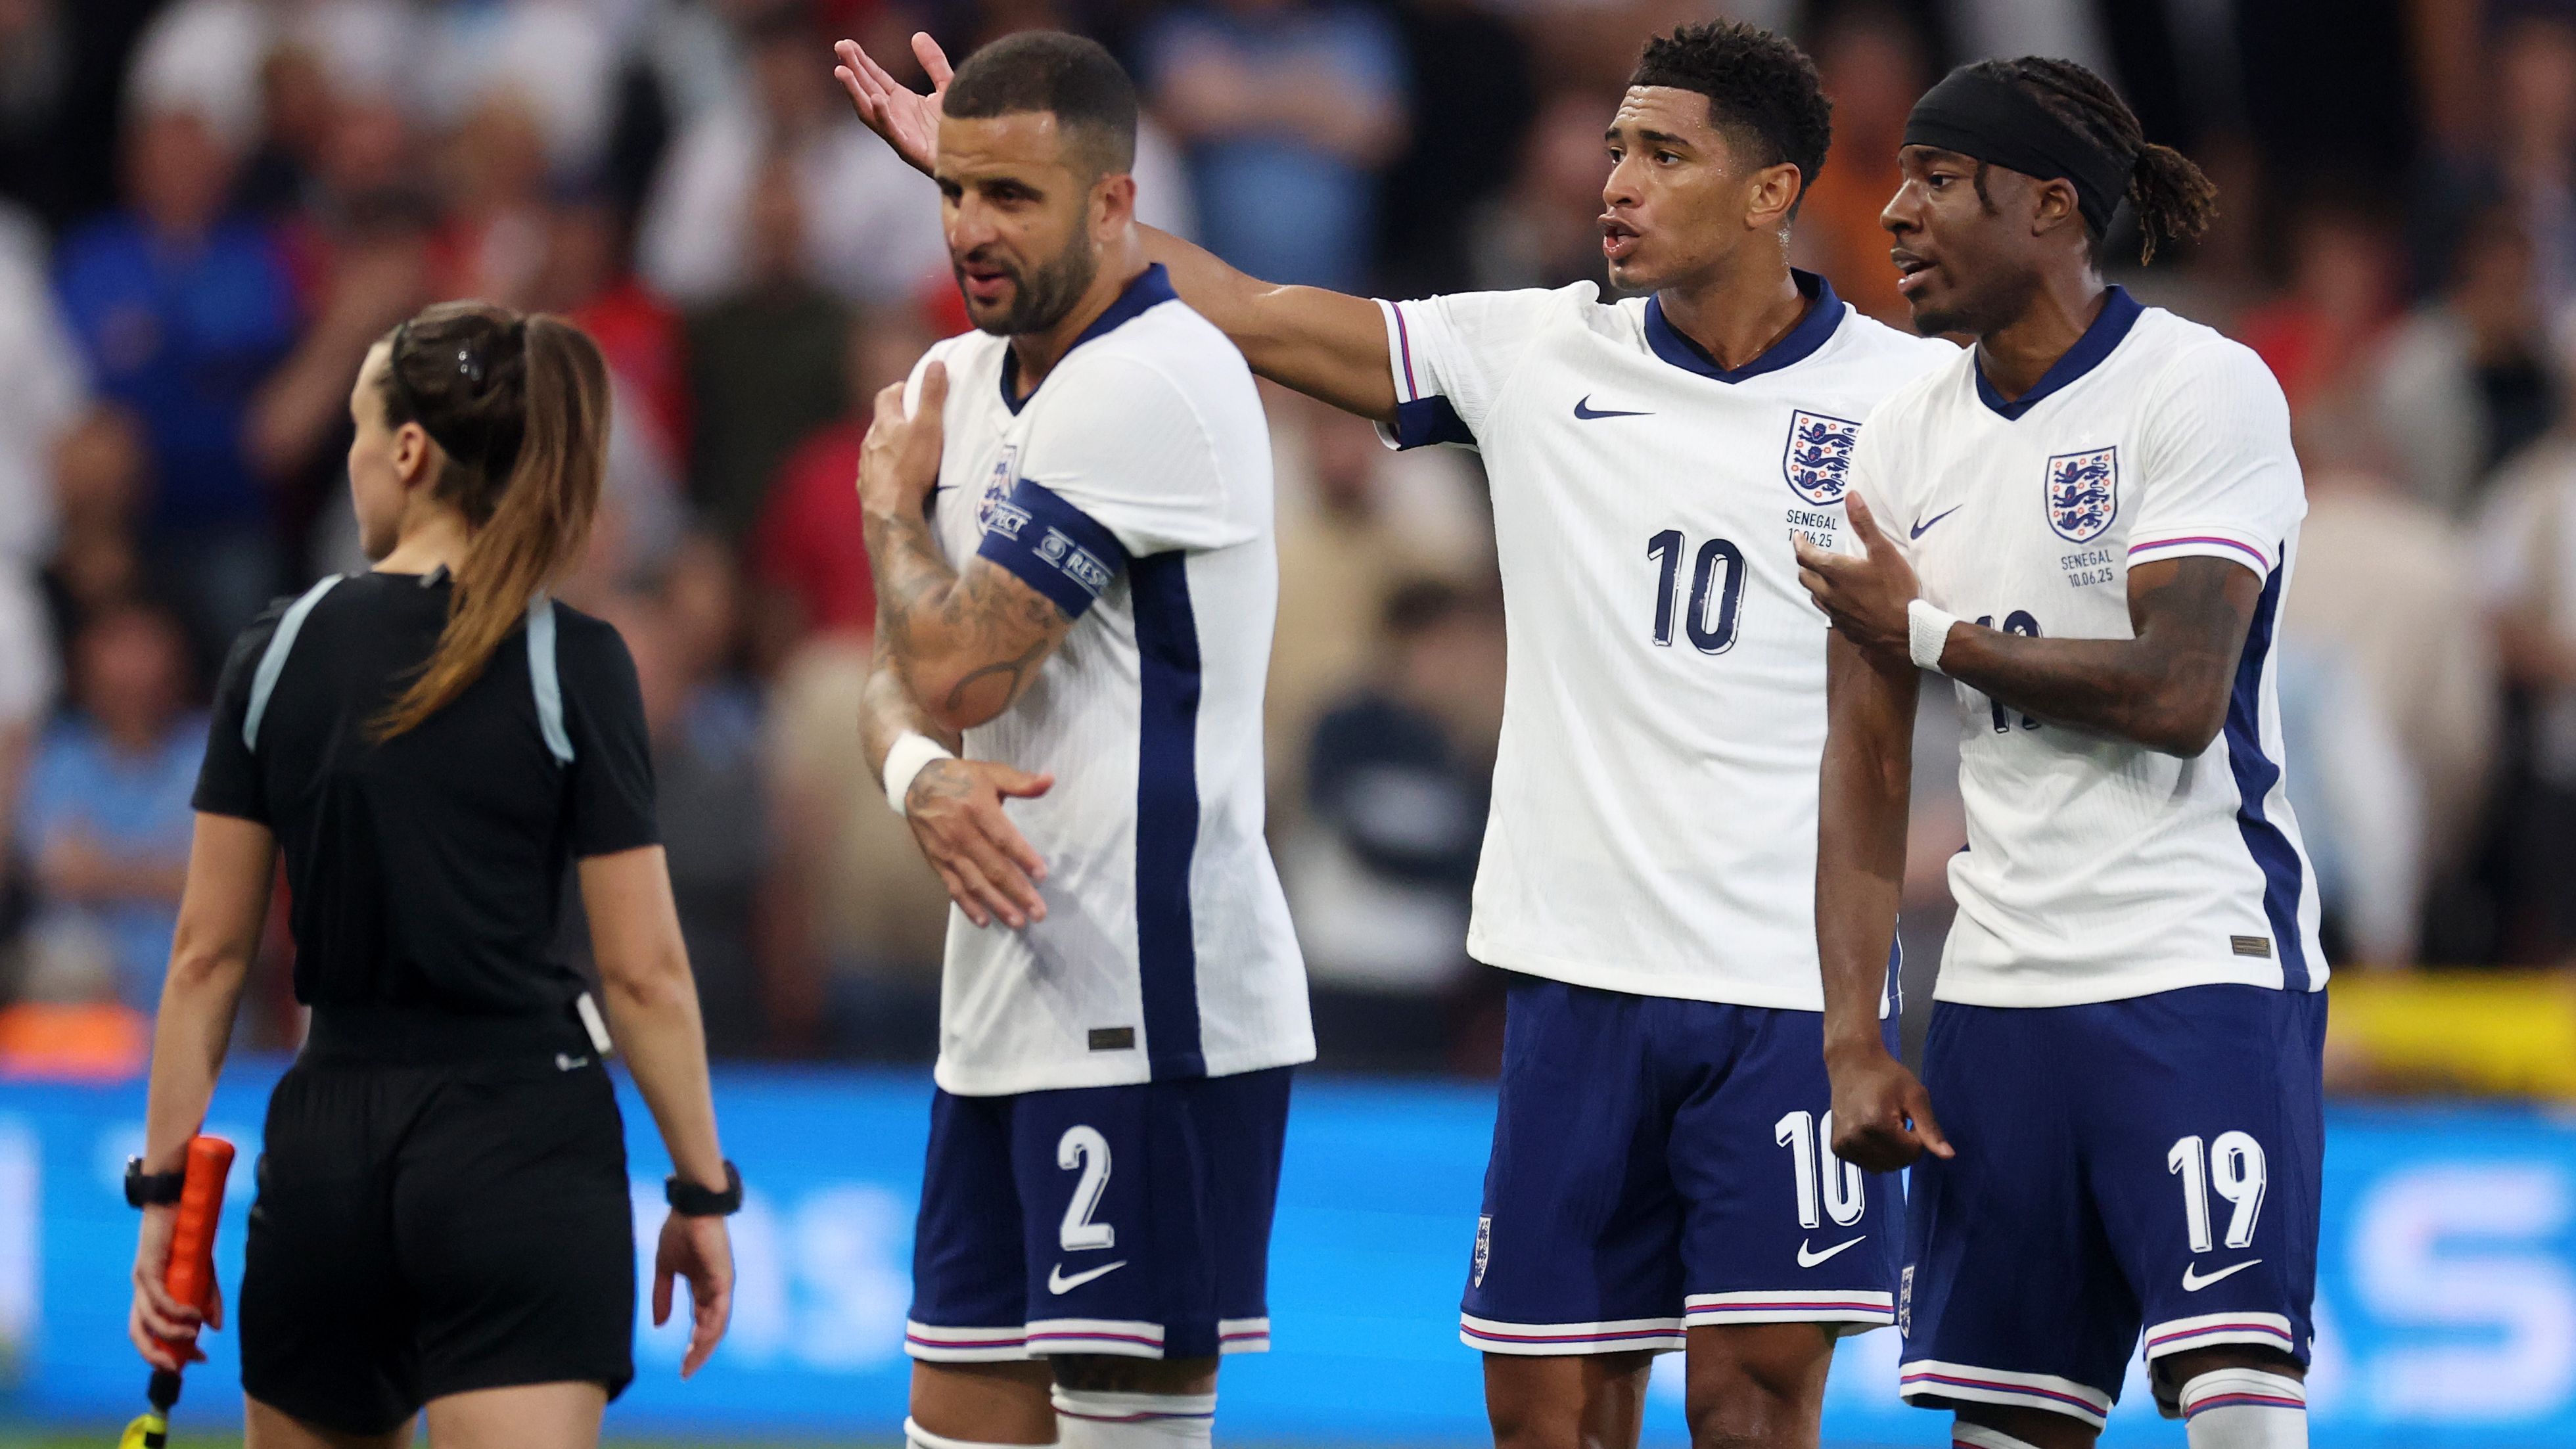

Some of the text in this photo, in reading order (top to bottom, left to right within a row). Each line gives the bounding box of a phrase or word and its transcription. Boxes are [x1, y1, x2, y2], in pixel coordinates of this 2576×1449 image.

[1786, 509, 1837, 530] SENEGAL
[1647, 529, 1747, 656] 10
[2061, 549, 2113, 570] SENEGAL
[2068, 567, 2113, 587] 10.06.25
[1057, 1124, 1115, 1251] 2
[2167, 1130, 2267, 1254] 19
